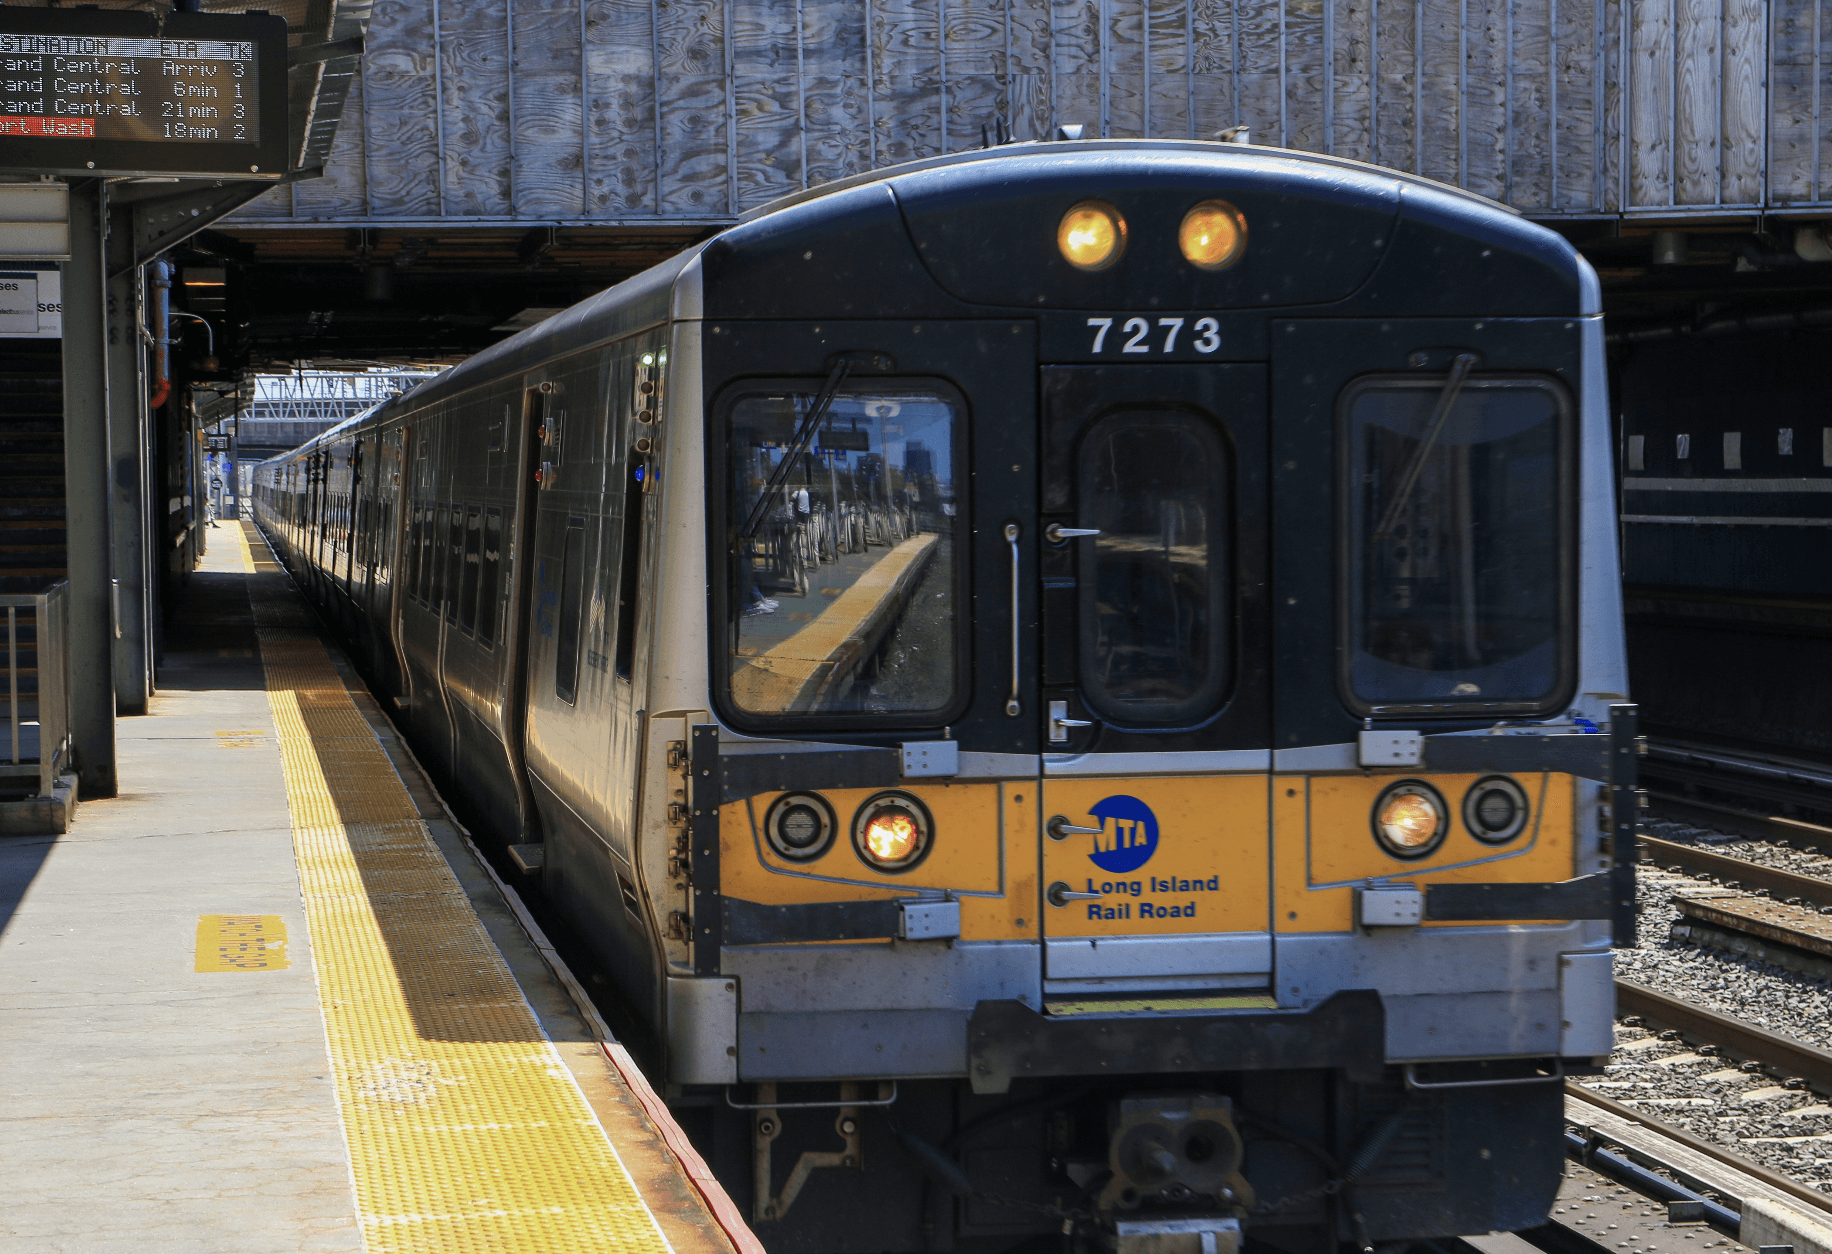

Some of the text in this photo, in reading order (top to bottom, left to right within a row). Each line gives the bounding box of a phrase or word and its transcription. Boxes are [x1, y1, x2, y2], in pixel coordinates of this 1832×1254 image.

[161, 41, 197, 58] ETA
[226, 43, 251, 59] TK
[0, 56, 244, 78] and Central Arriv 3
[0, 77, 43, 93] and
[54, 77, 141, 96] Central
[234, 83, 243, 99] 1
[55, 98, 142, 117] Central
[233, 103, 245, 119] 3
[43, 119, 94, 136] Wash
[233, 124, 246, 140] 2
[1086, 316, 1221, 354] 7273
[1088, 814, 1148, 855] MTA
[1087, 875, 1220, 897] Long Island
[1088, 901, 1196, 920] Rail Road
